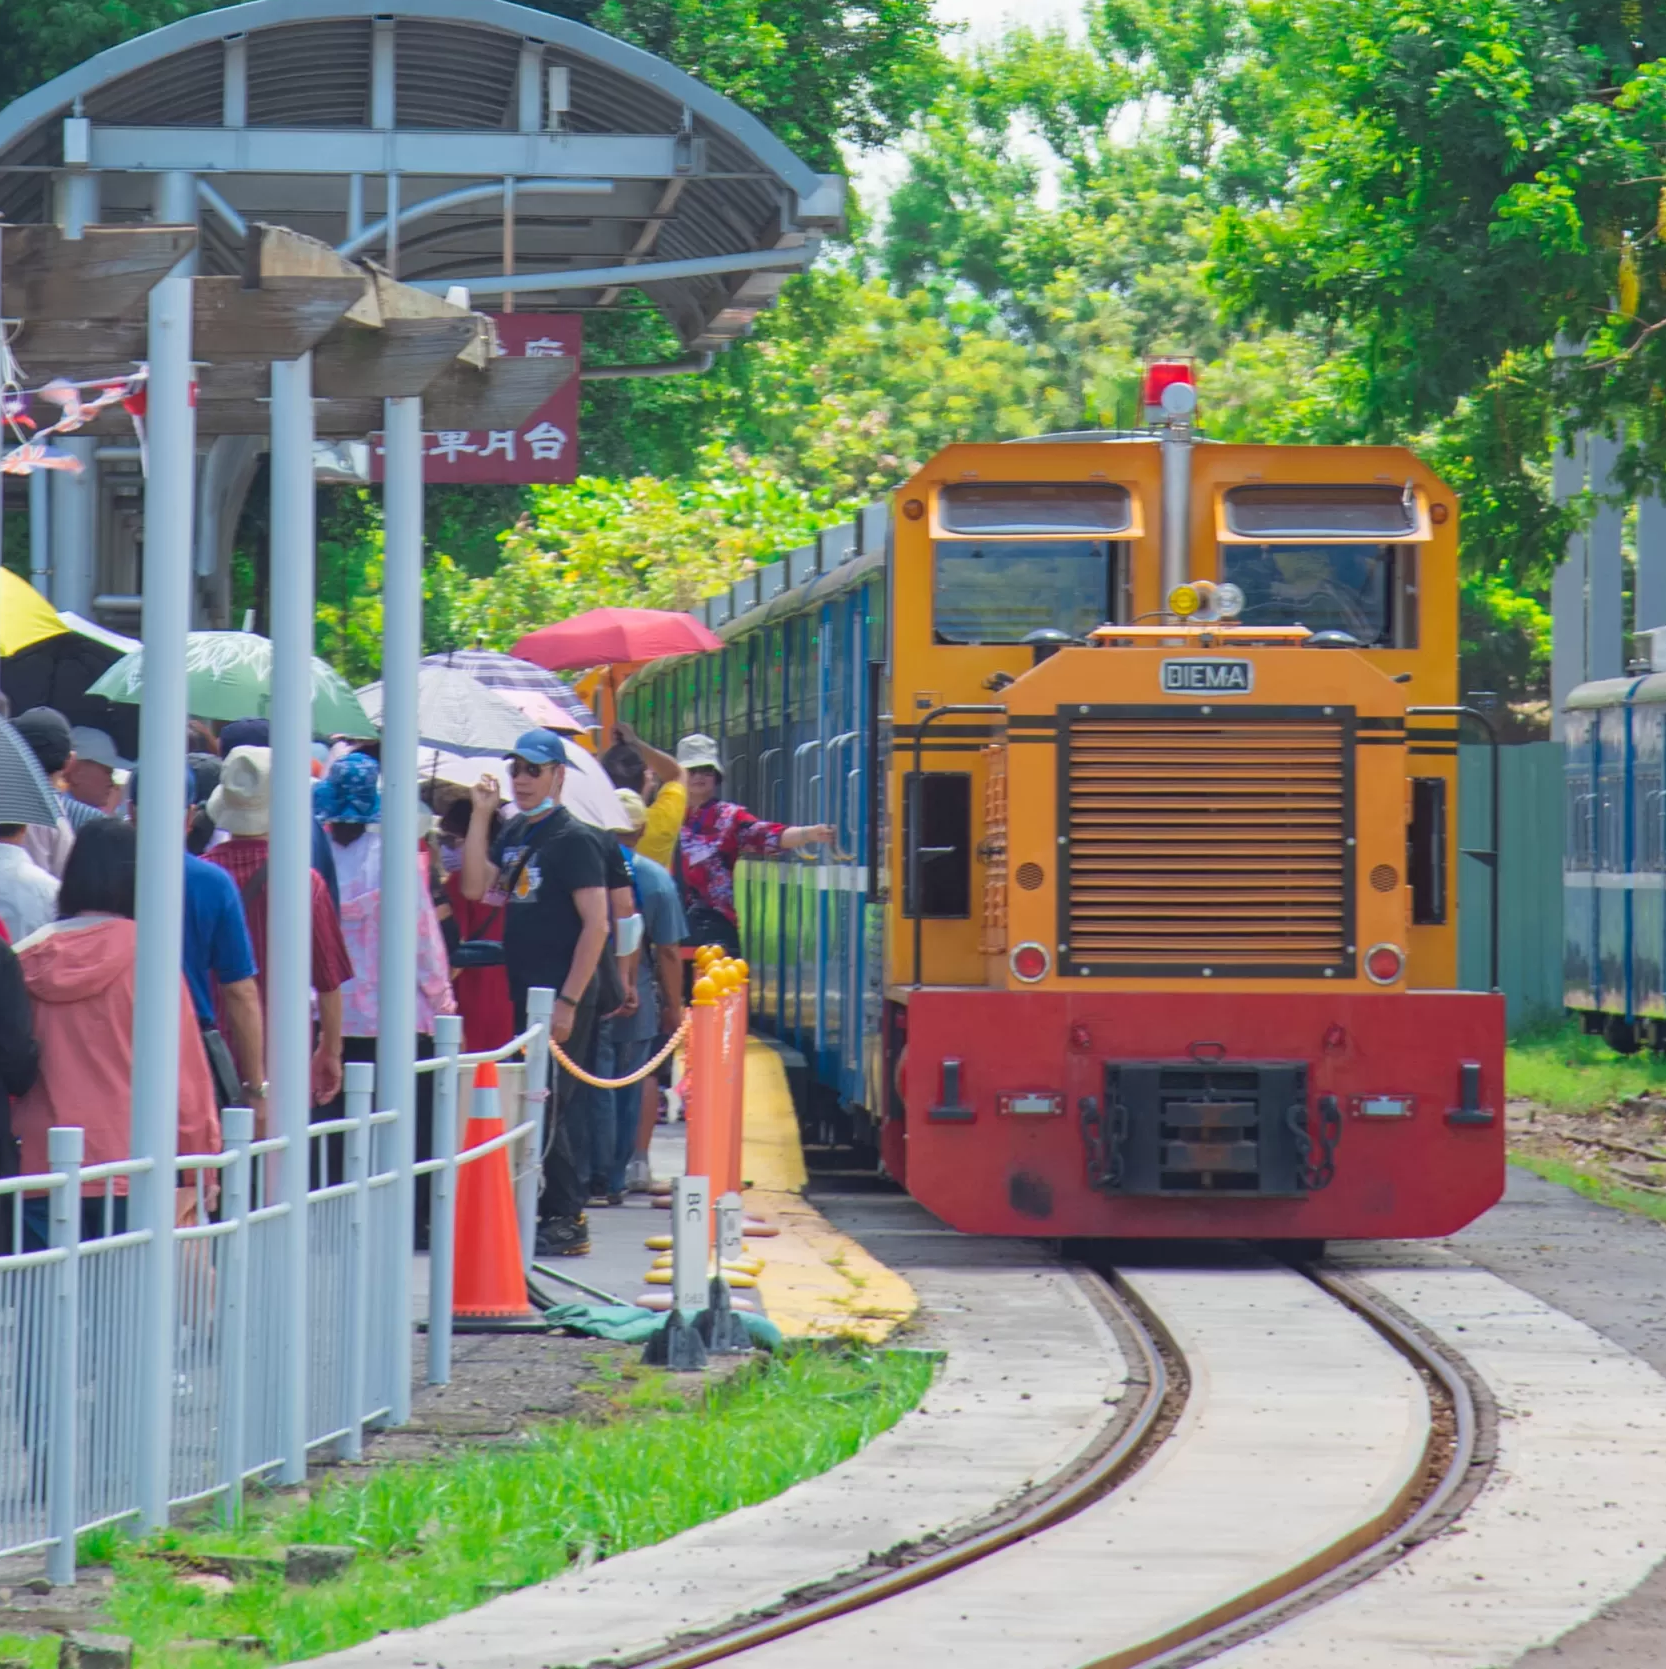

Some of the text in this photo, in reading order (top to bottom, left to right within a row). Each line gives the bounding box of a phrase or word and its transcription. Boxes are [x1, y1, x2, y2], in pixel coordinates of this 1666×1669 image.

[376, 422, 568, 463] 車月台
[1167, 665, 1246, 687] DIEMA
[687, 1193, 701, 1222] BC
